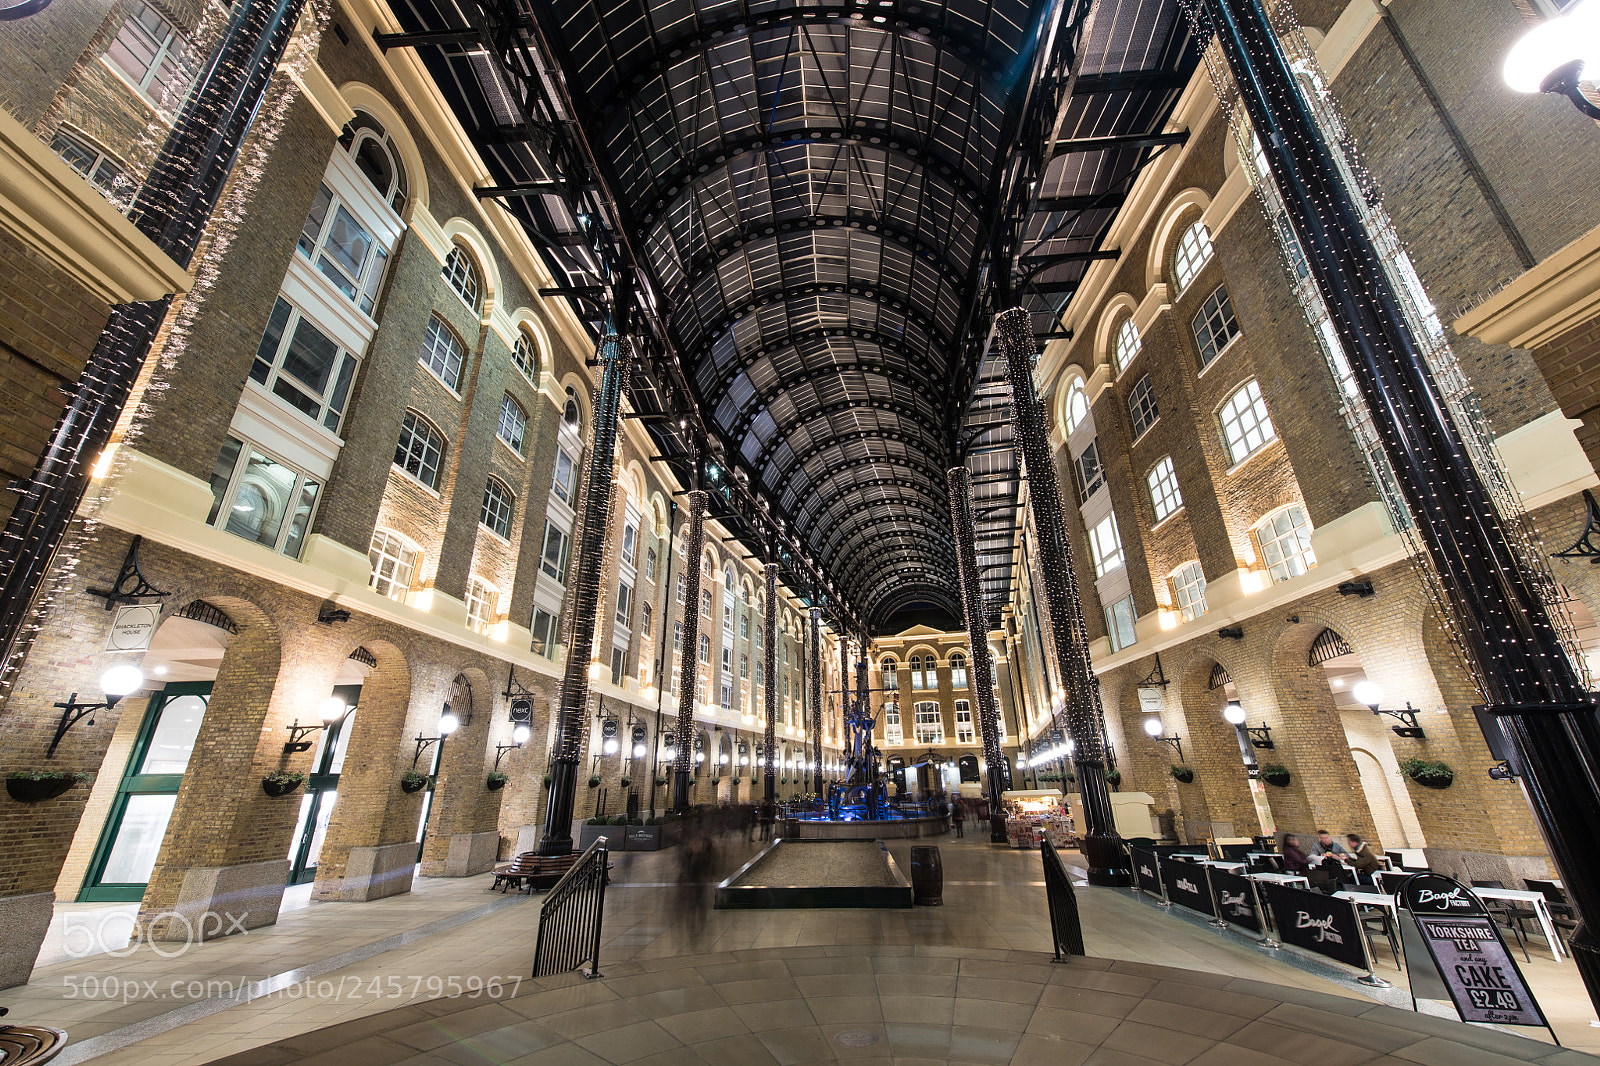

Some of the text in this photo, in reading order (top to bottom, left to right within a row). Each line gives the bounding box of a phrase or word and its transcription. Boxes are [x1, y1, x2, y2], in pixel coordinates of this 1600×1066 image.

[1418, 887, 1467, 910] Bagel
[1450, 899, 1471, 907] FACTORY
[1296, 910, 1340, 942] Bagel
[1427, 924, 1494, 940] YORKSHIRE
[1454, 939, 1479, 951] TEA
[1454, 965, 1512, 989] CAKE
[1470, 990, 1518, 1010] £2.49
[1484, 1010, 1502, 1021] after
